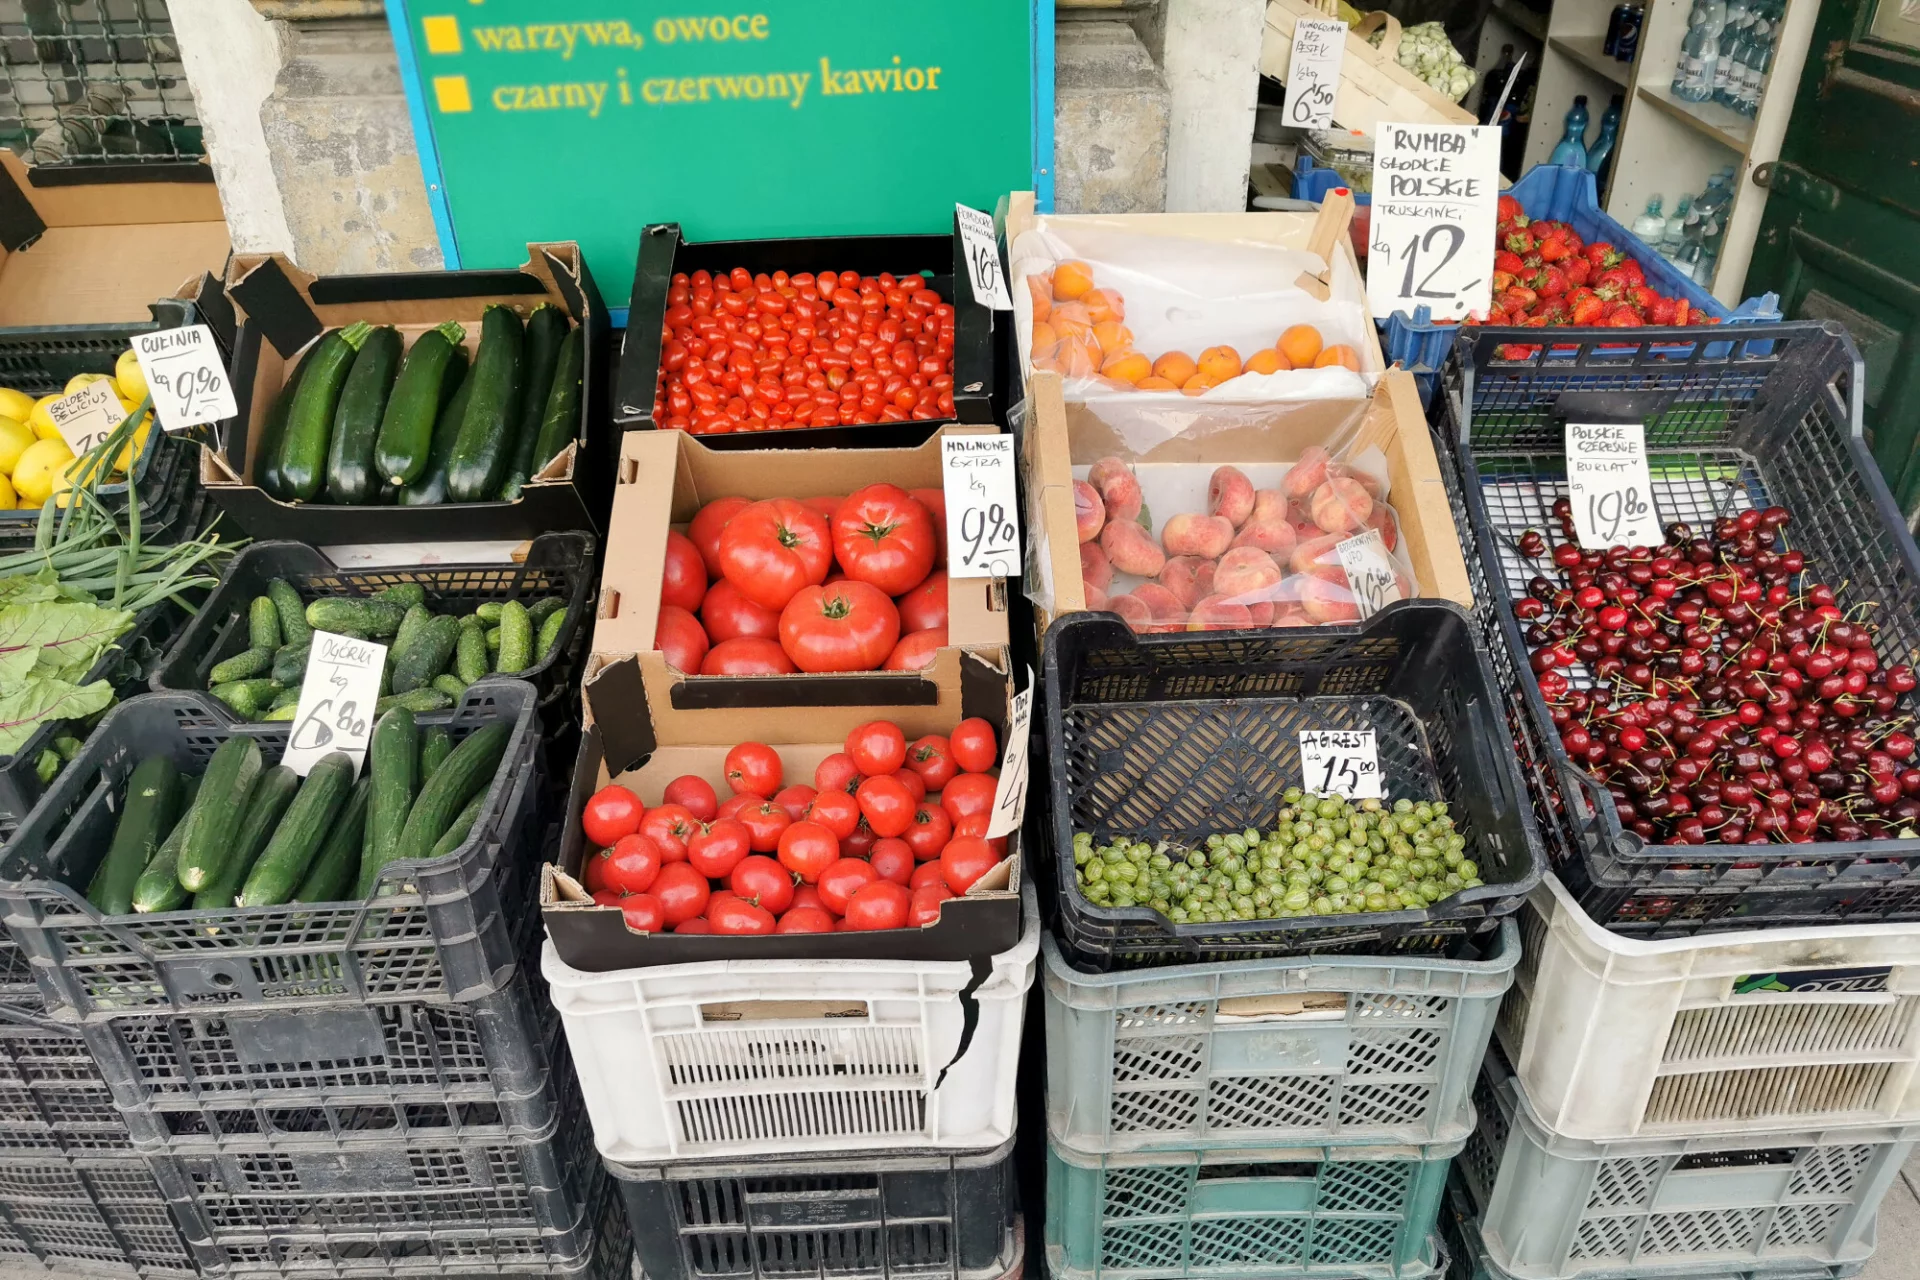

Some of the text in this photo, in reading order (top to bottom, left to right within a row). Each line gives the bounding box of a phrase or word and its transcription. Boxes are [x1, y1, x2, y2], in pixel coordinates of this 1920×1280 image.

[472, 14, 769, 60] warzywa, owoce
[492, 55, 941, 118] czarny i czerwony kawior
[1372, 223, 1391, 266] kg
[141, 329, 202, 354] CUKINIA
[151, 367, 171, 393] kg
[50, 387, 92, 414] GOLDEN
[54, 391, 108, 422] DELICIUS
[950, 456, 1002, 468] EXTRA
[969, 472, 986, 497] kg
[329, 666, 349, 697] kg
[1301, 731, 1372, 750] AGRIST
